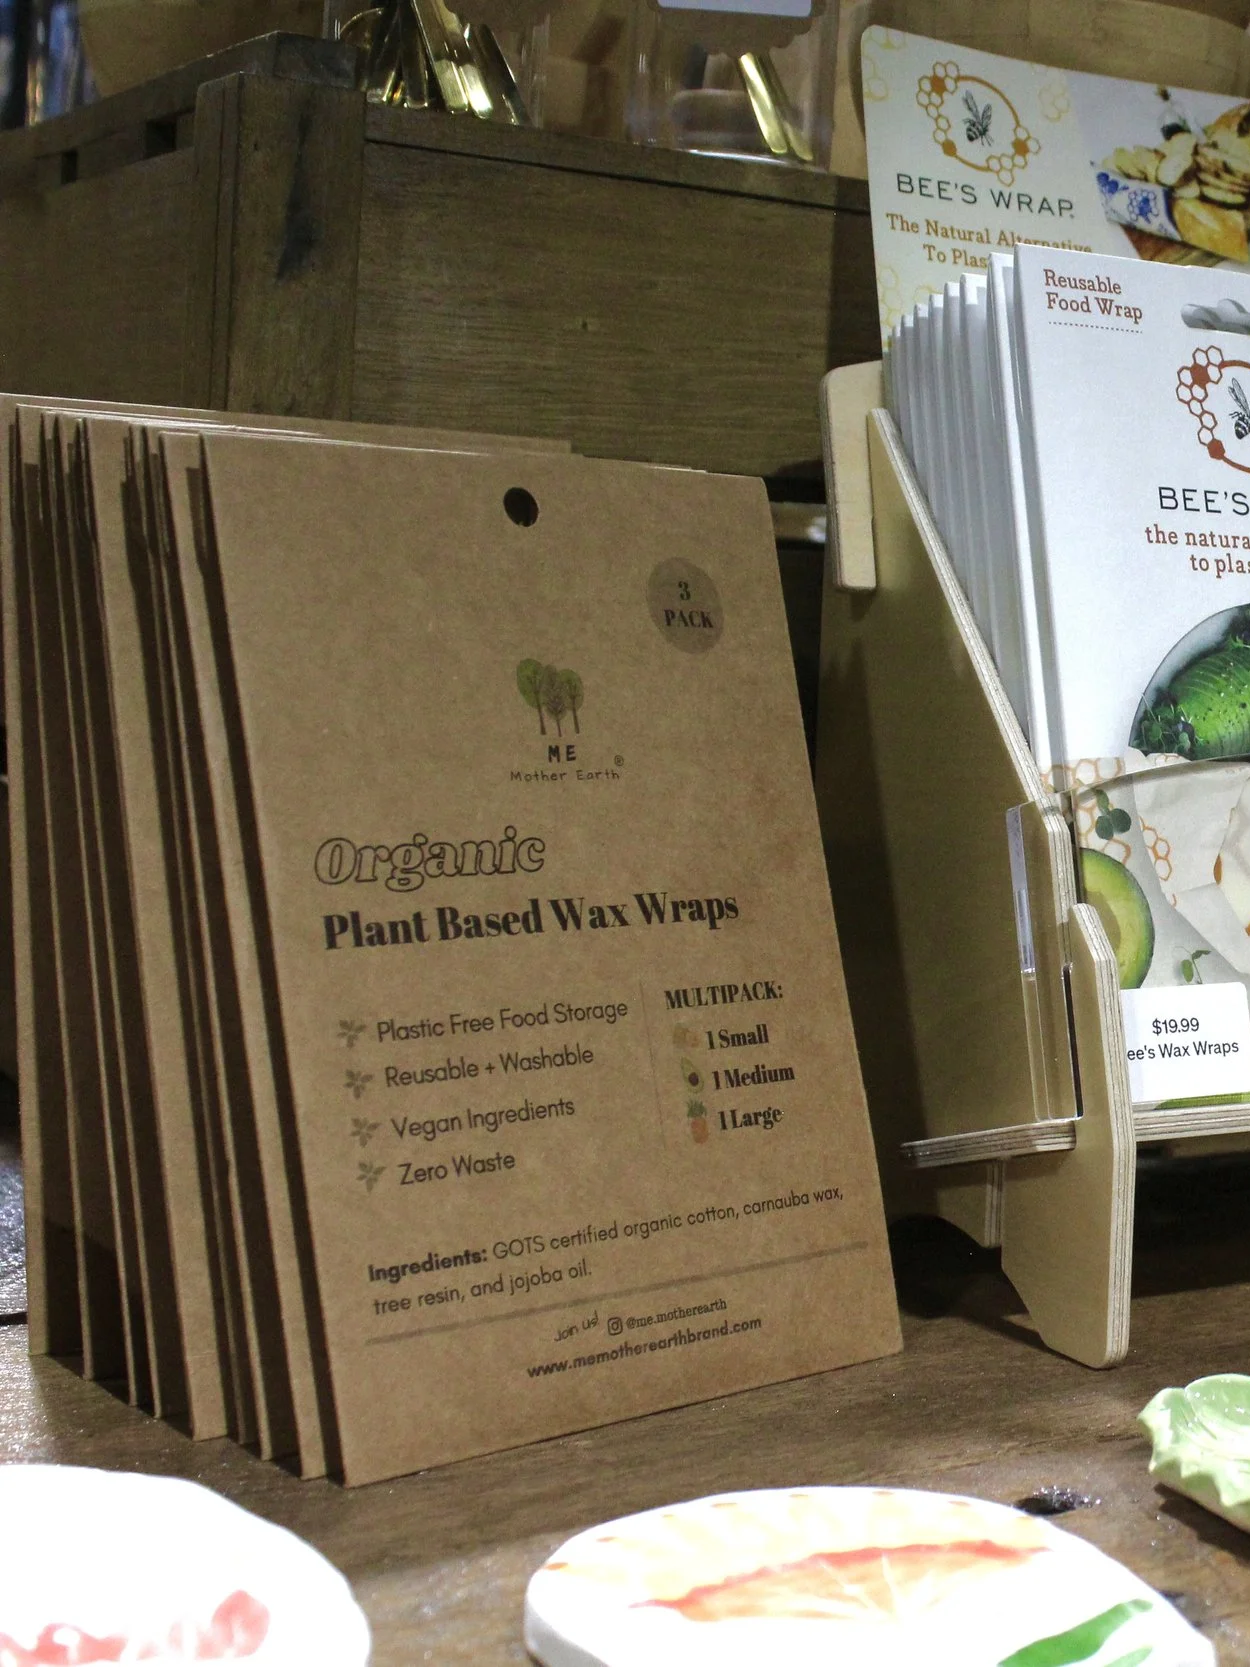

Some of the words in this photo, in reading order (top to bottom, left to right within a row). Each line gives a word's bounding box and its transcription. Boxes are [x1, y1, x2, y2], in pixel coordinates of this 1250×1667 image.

[896, 173, 978, 205] BEE'S
[886, 213, 920, 233] The
[925, 219, 991, 245] Natural
[923, 244, 947, 264] To
[952, 249, 989, 270] Plas
[1043, 269, 1122, 295] Reusable
[1046, 292, 1091, 314] Food
[1095, 297, 1143, 325] Wrap
[1158, 486, 1250, 516] BEE'S
[1144, 524, 1179, 546] the
[1190, 554, 1210, 572] to
[678, 580, 691, 601] 3
[664, 609, 714, 629] PACK
[510, 770, 567, 782] Mother
[314, 825, 547, 893] Organic
[322, 911, 430, 950] Plant
[437, 899, 544, 942] Based
[549, 898, 631, 932] Wax
[633, 891, 740, 930] Wraps
[664, 981, 784, 1011] MULTIPACK:
[377, 1020, 445, 1043] Plastic
[449, 1013, 495, 1036] Free
[499, 1005, 549, 1030] Food
[553, 1000, 629, 1025] Storage
[1152, 1017, 1199, 1036] $19.99
[706, 1030, 716, 1050] 1
[718, 1024, 769, 1048] Small
[1126, 1045, 1156, 1060] ee's
[1158, 1043, 1190, 1058] Wax
[1193, 1040, 1239, 1057] Wraps
[384, 1058, 479, 1088] Reusable
[484, 1062, 495, 1075] +
[499, 1044, 594, 1073] Washable
[712, 1070, 723, 1090] 1
[724, 1065, 796, 1089] Medium
[391, 1109, 462, 1142] Vegan
[467, 1098, 576, 1134] Ingredients
[717, 1111, 729, 1131] 1
[730, 1106, 784, 1132] Large
[399, 1161, 448, 1186] Zero
[451, 1151, 516, 1178] Waste
[368, 1246, 488, 1284] Ingredients:
[493, 1235, 546, 1260] GOTS
[550, 1221, 619, 1251] certified
[623, 1214, 683, 1240] organic
[686, 1203, 741, 1227] cotton,
[743, 1192, 811, 1217] carnauba
[813, 1186, 845, 1204] wax,
[373, 1297, 412, 1315] tree
[417, 1286, 465, 1308] resin,
[470, 1276, 504, 1299] and
[509, 1266, 564, 1296] jojoba
[568, 1258, 593, 1280] oil.
[553, 1324, 579, 1342] Join
[626, 1298, 728, 1330] @me.motherearth
[527, 1317, 763, 1378] www.memotherearthbrand.com
